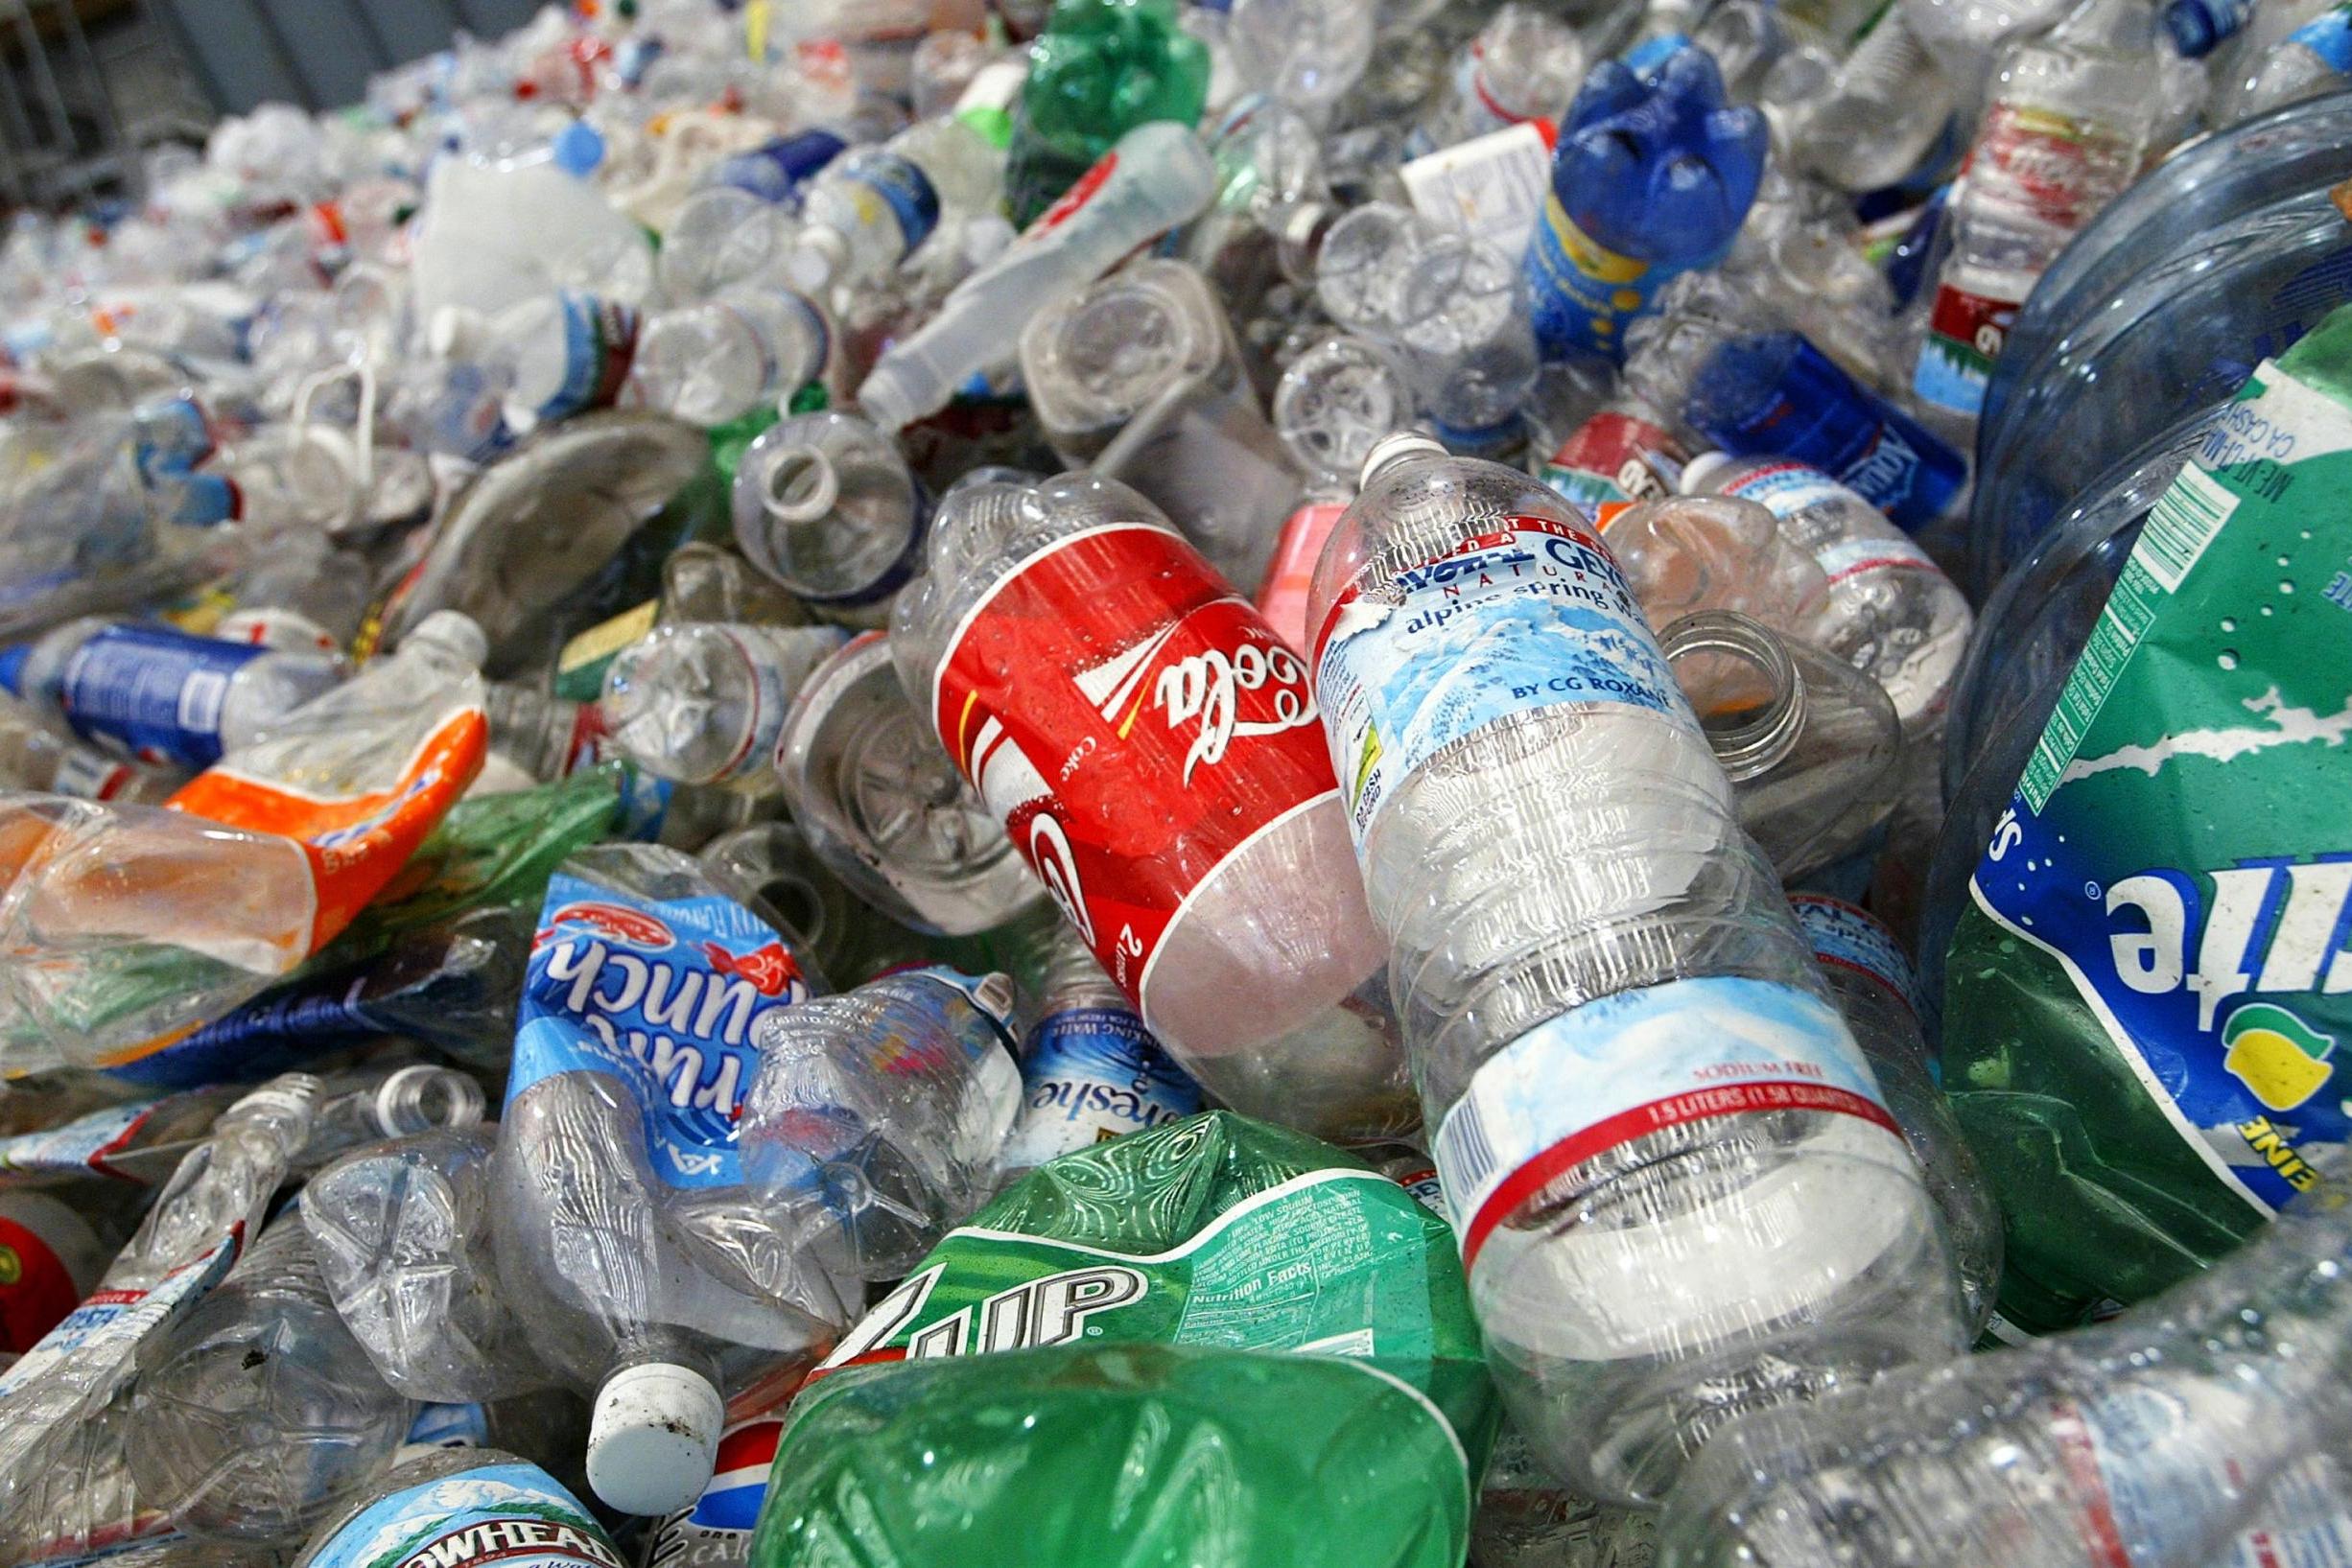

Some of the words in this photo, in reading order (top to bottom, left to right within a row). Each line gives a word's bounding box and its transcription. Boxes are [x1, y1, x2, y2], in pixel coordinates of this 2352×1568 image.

[2226, 405, 2270, 443] CASH
[2266, 426, 2297, 458] CA
[1541, 520, 1577, 541] THE
[1443, 563, 1618, 599] NATURA
[1406, 594, 1503, 634] alpine
[1514, 578, 1610, 611] spring
[1513, 679, 1540, 701] BY
[1547, 677, 1585, 694] CG
[1153, 644, 1320, 790] Cola
[1060, 737, 1096, 783] Coke
[1119, 923, 1142, 957] 2
[1678, 1085, 1748, 1117] LITERS
[2235, 1113, 2320, 1195] EINE
[1276, 1196, 1313, 1215] SODIUM
[1191, 1277, 1262, 1305] Nutrition
[1267, 1261, 1311, 1287] Facts
[699, 1530, 737, 1540] one
